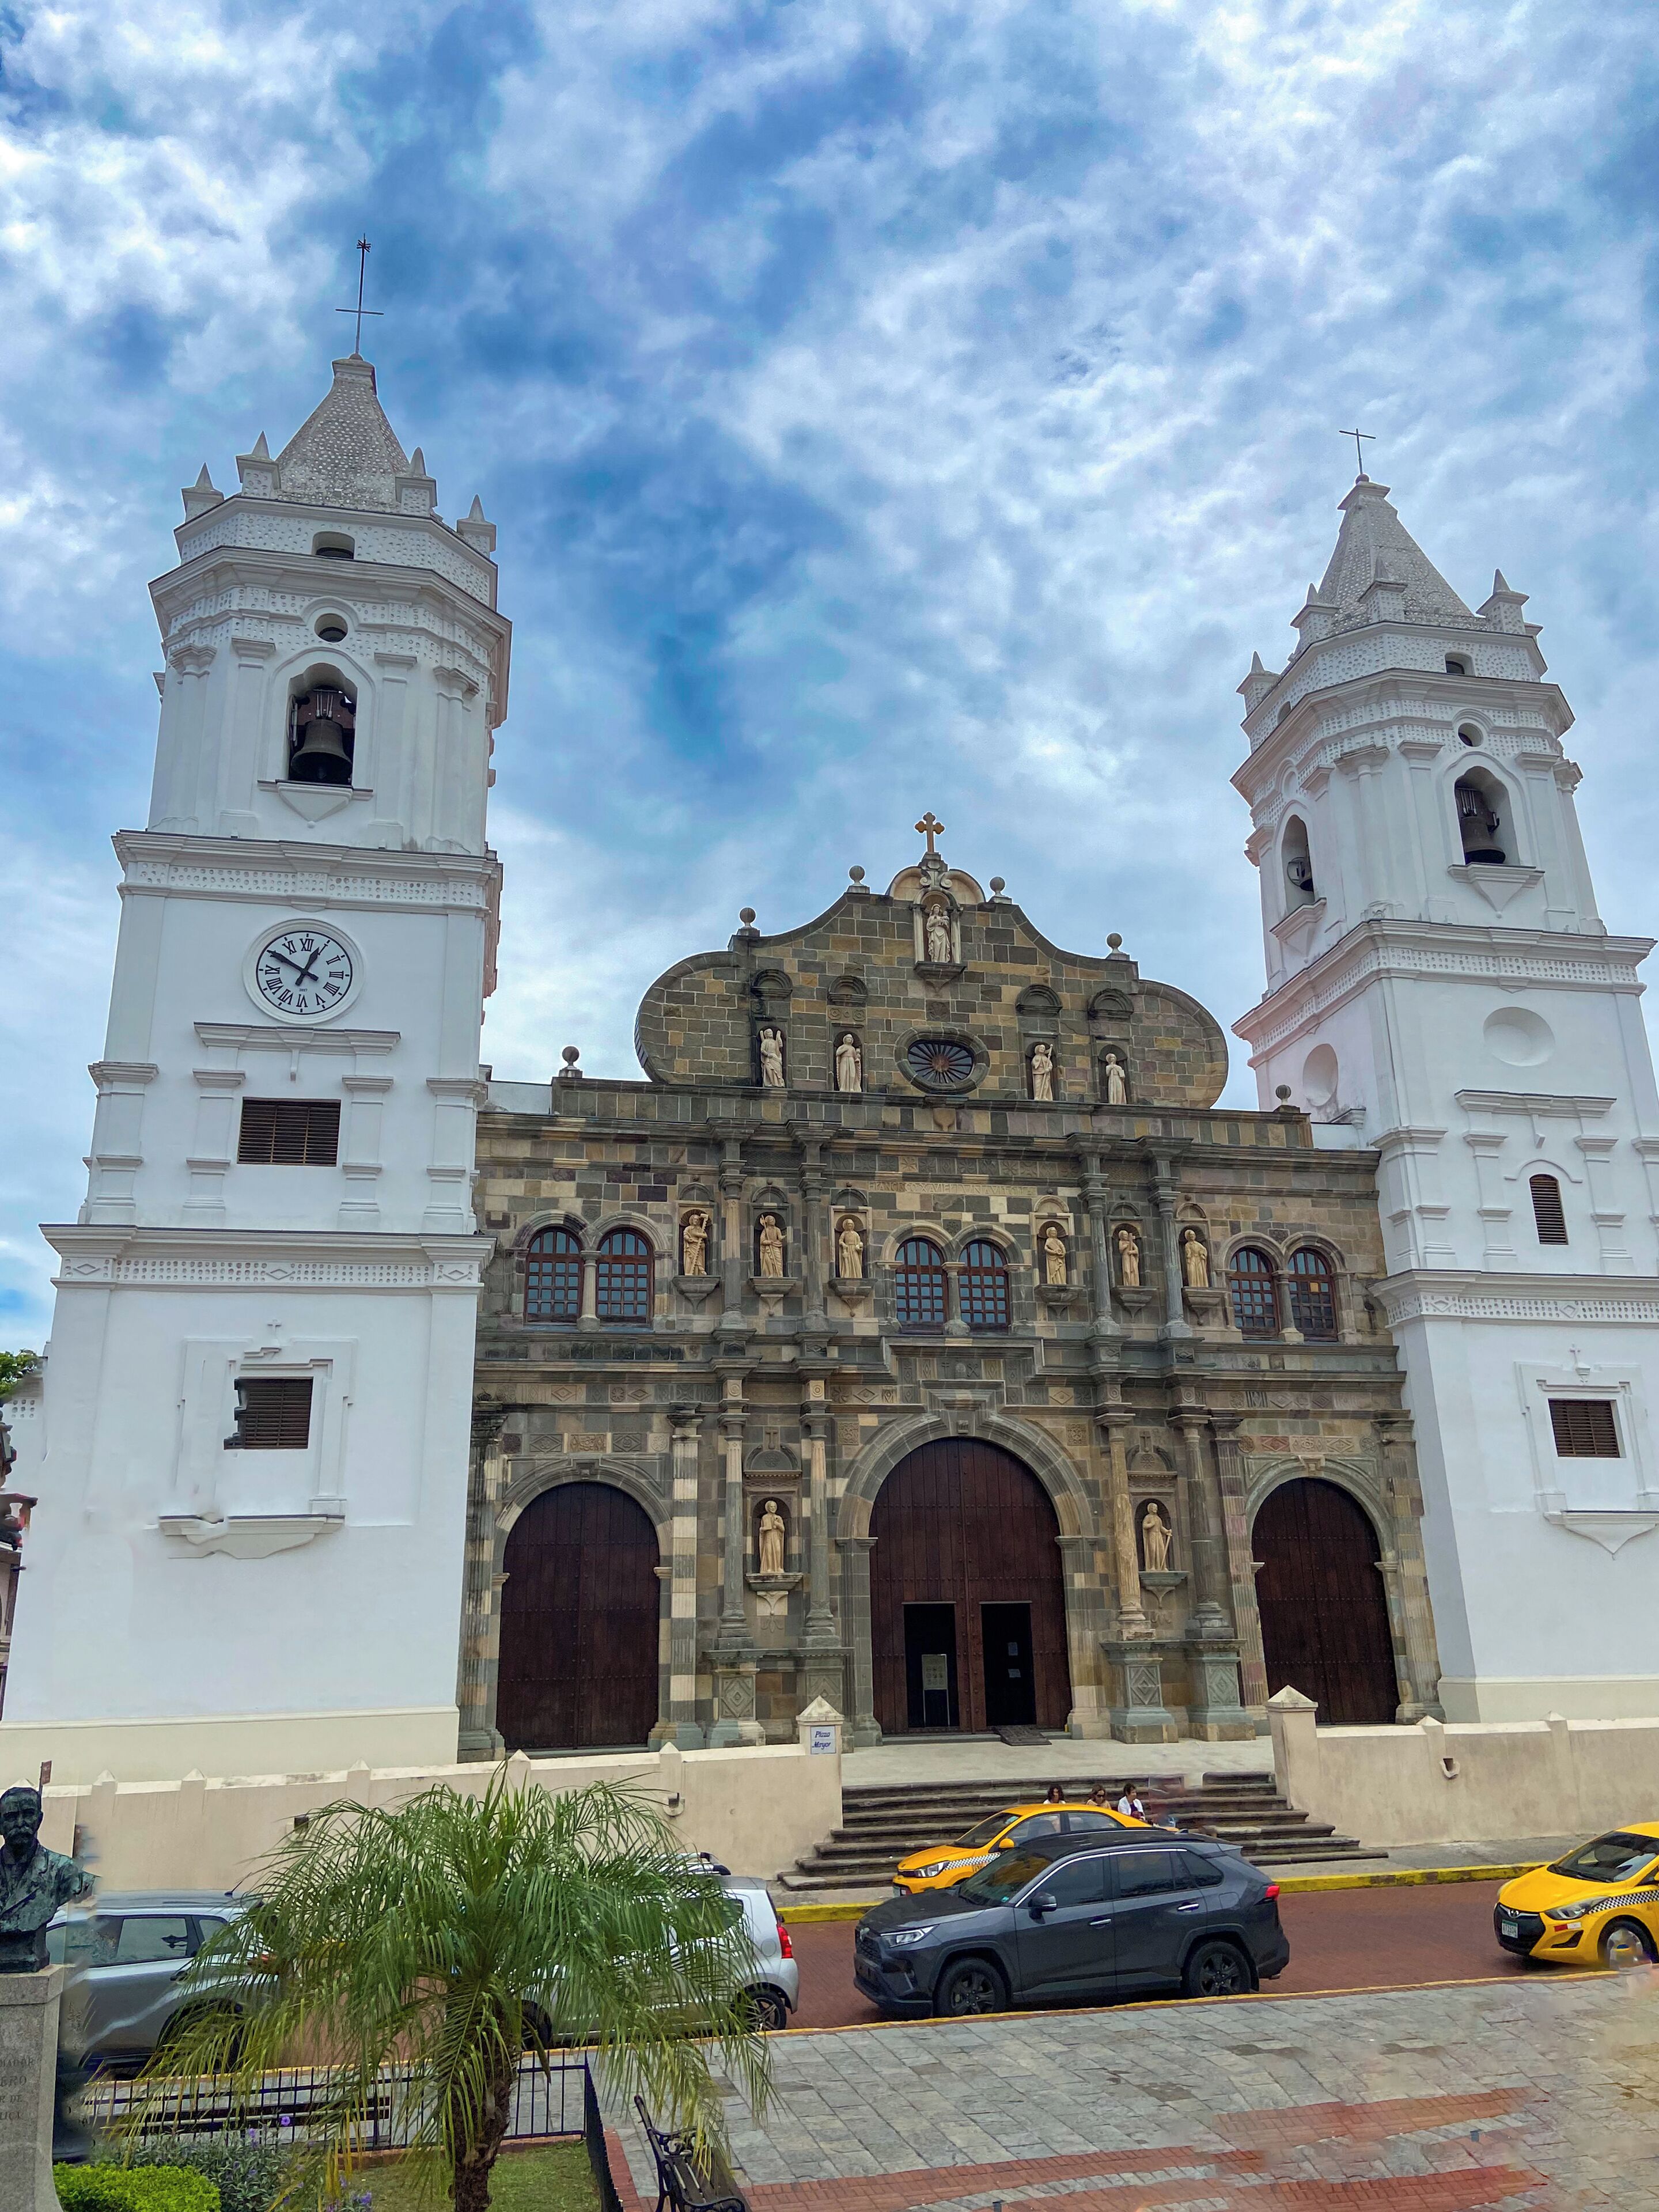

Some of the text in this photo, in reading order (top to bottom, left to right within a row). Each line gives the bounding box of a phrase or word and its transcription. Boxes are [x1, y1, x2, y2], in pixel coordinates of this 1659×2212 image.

[282, 940, 297, 955] XI
[300, 938, 315, 952] XII
[326, 955, 341, 965] II
[265, 964, 281, 975] IX
[329, 971, 344, 980] III
[266, 978, 284, 995] VIII
[278, 989, 294, 1005] VII
[296, 994, 308, 1007] VI
[315, 993, 325, 1005] V
[812, 1741, 831, 1750] Mayor
